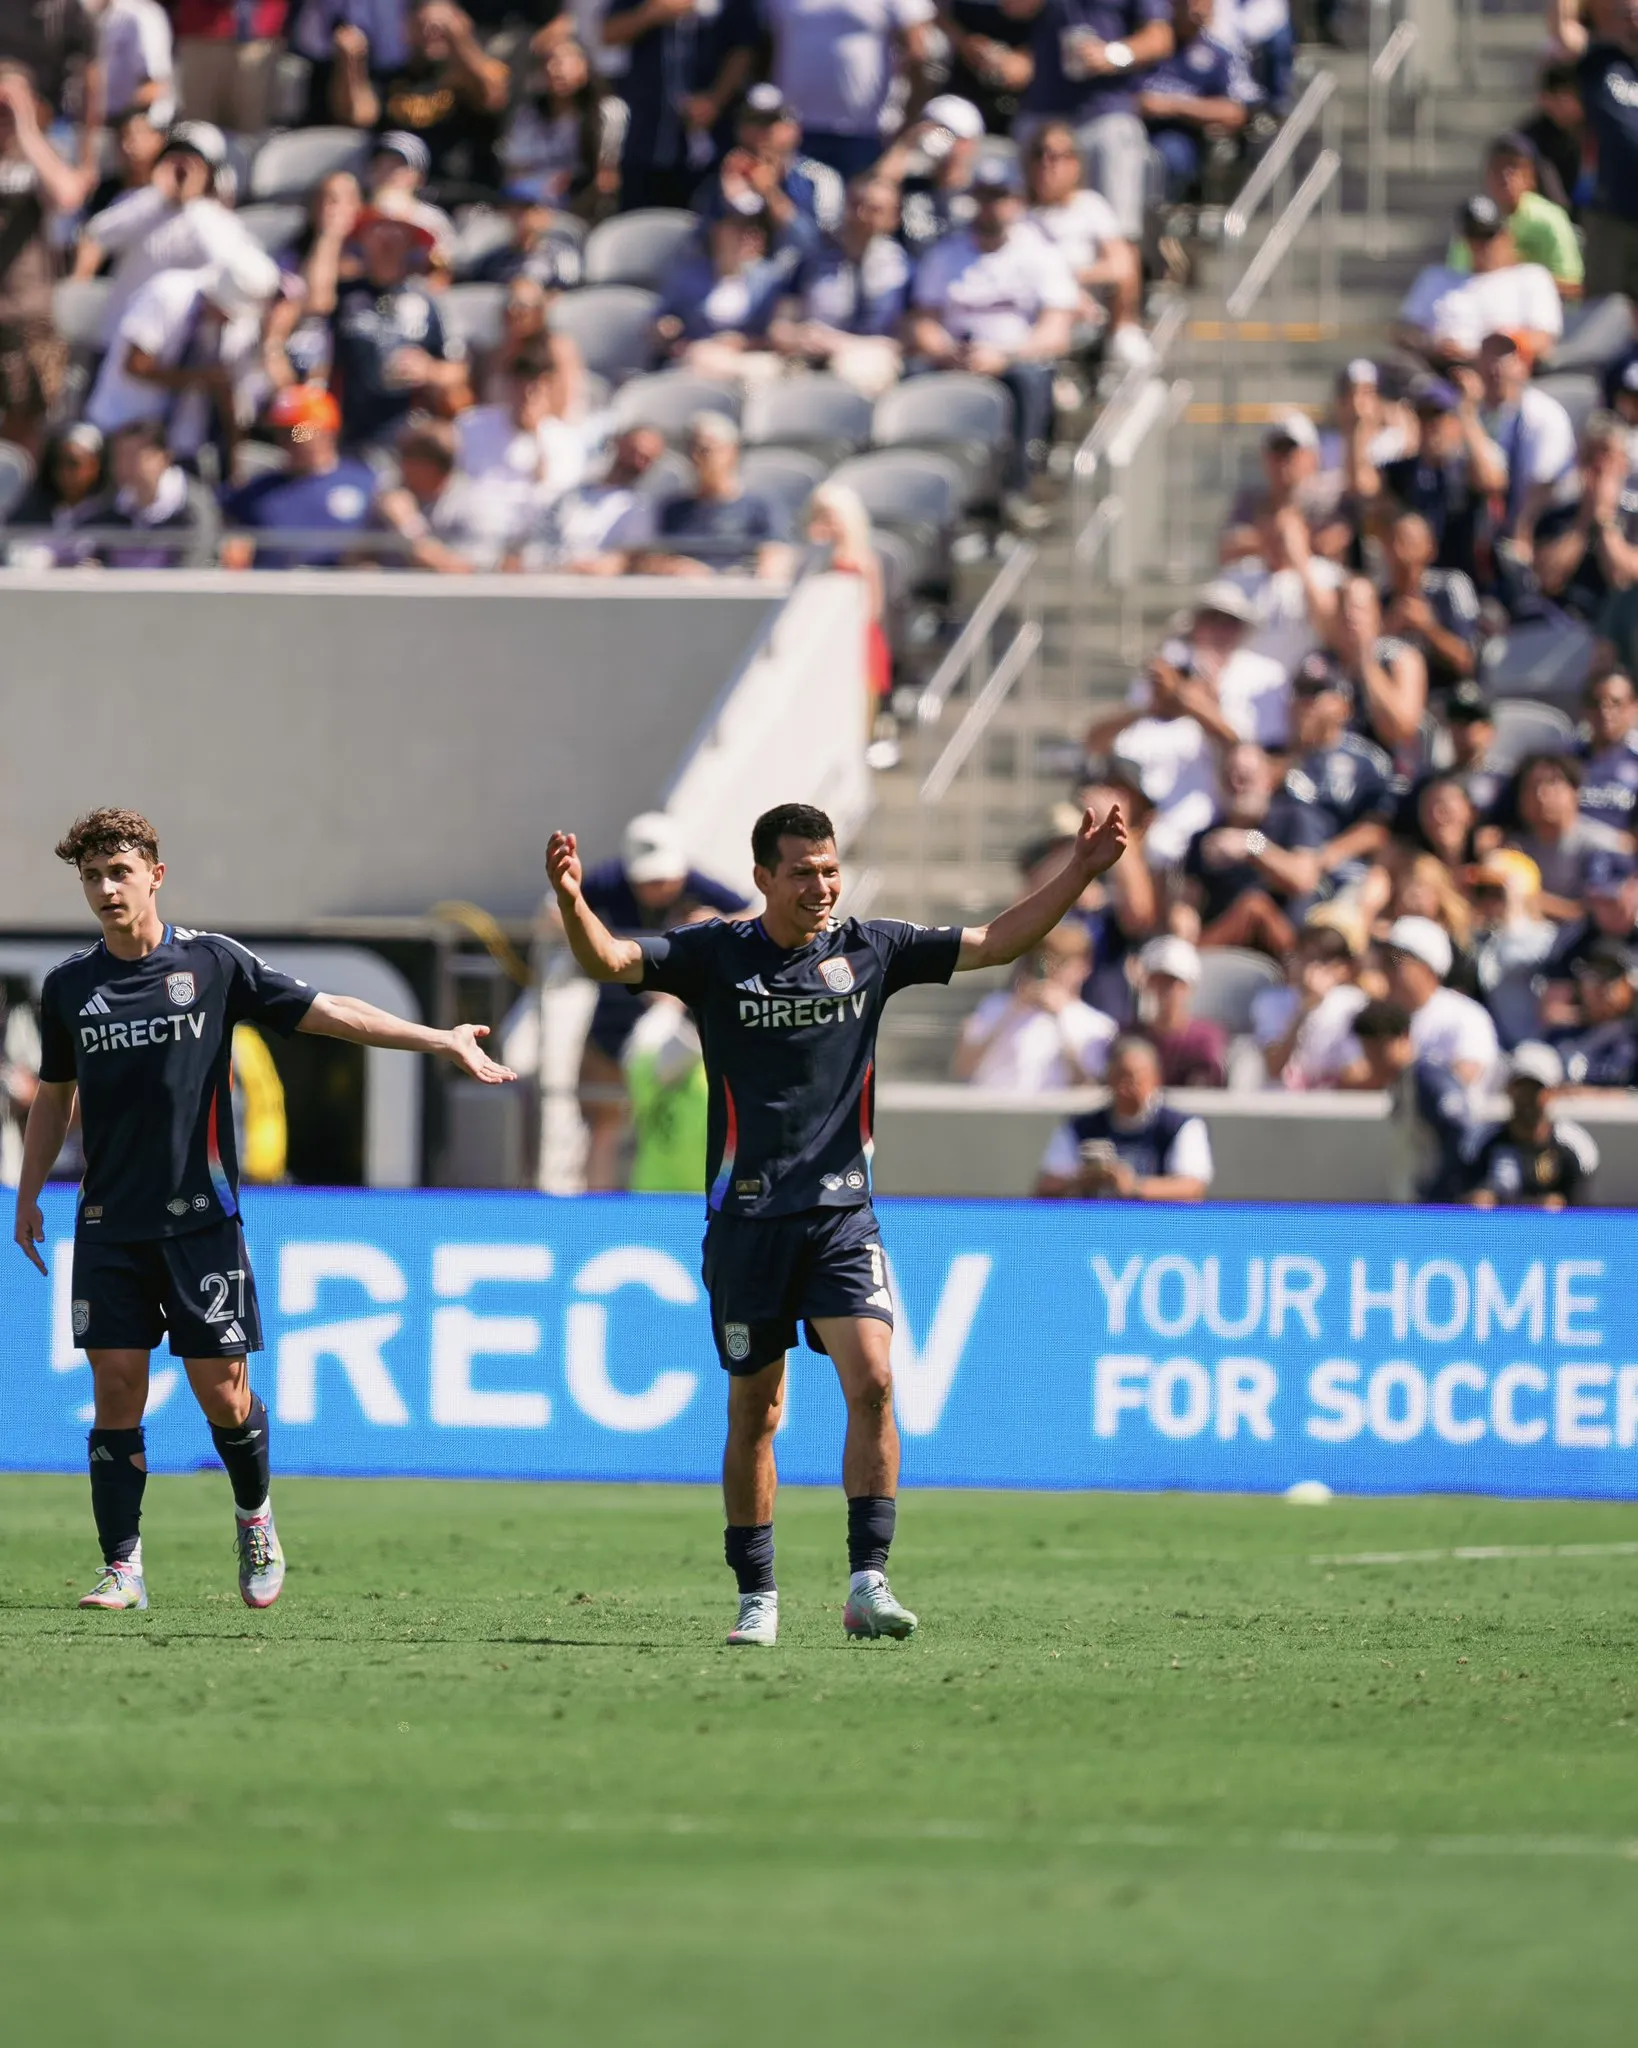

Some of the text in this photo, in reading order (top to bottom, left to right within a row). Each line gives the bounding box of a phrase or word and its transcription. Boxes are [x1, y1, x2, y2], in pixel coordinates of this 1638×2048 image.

[80, 1011, 206, 1053] DIRECTV
[738, 990, 867, 1028] DIRECTV
[195, 1198, 206, 1208] SD
[200, 1269, 245, 1324] 27
[1091, 1253, 1605, 1347] YOUR HOME
[1093, 1353, 1278, 1441] FOR
